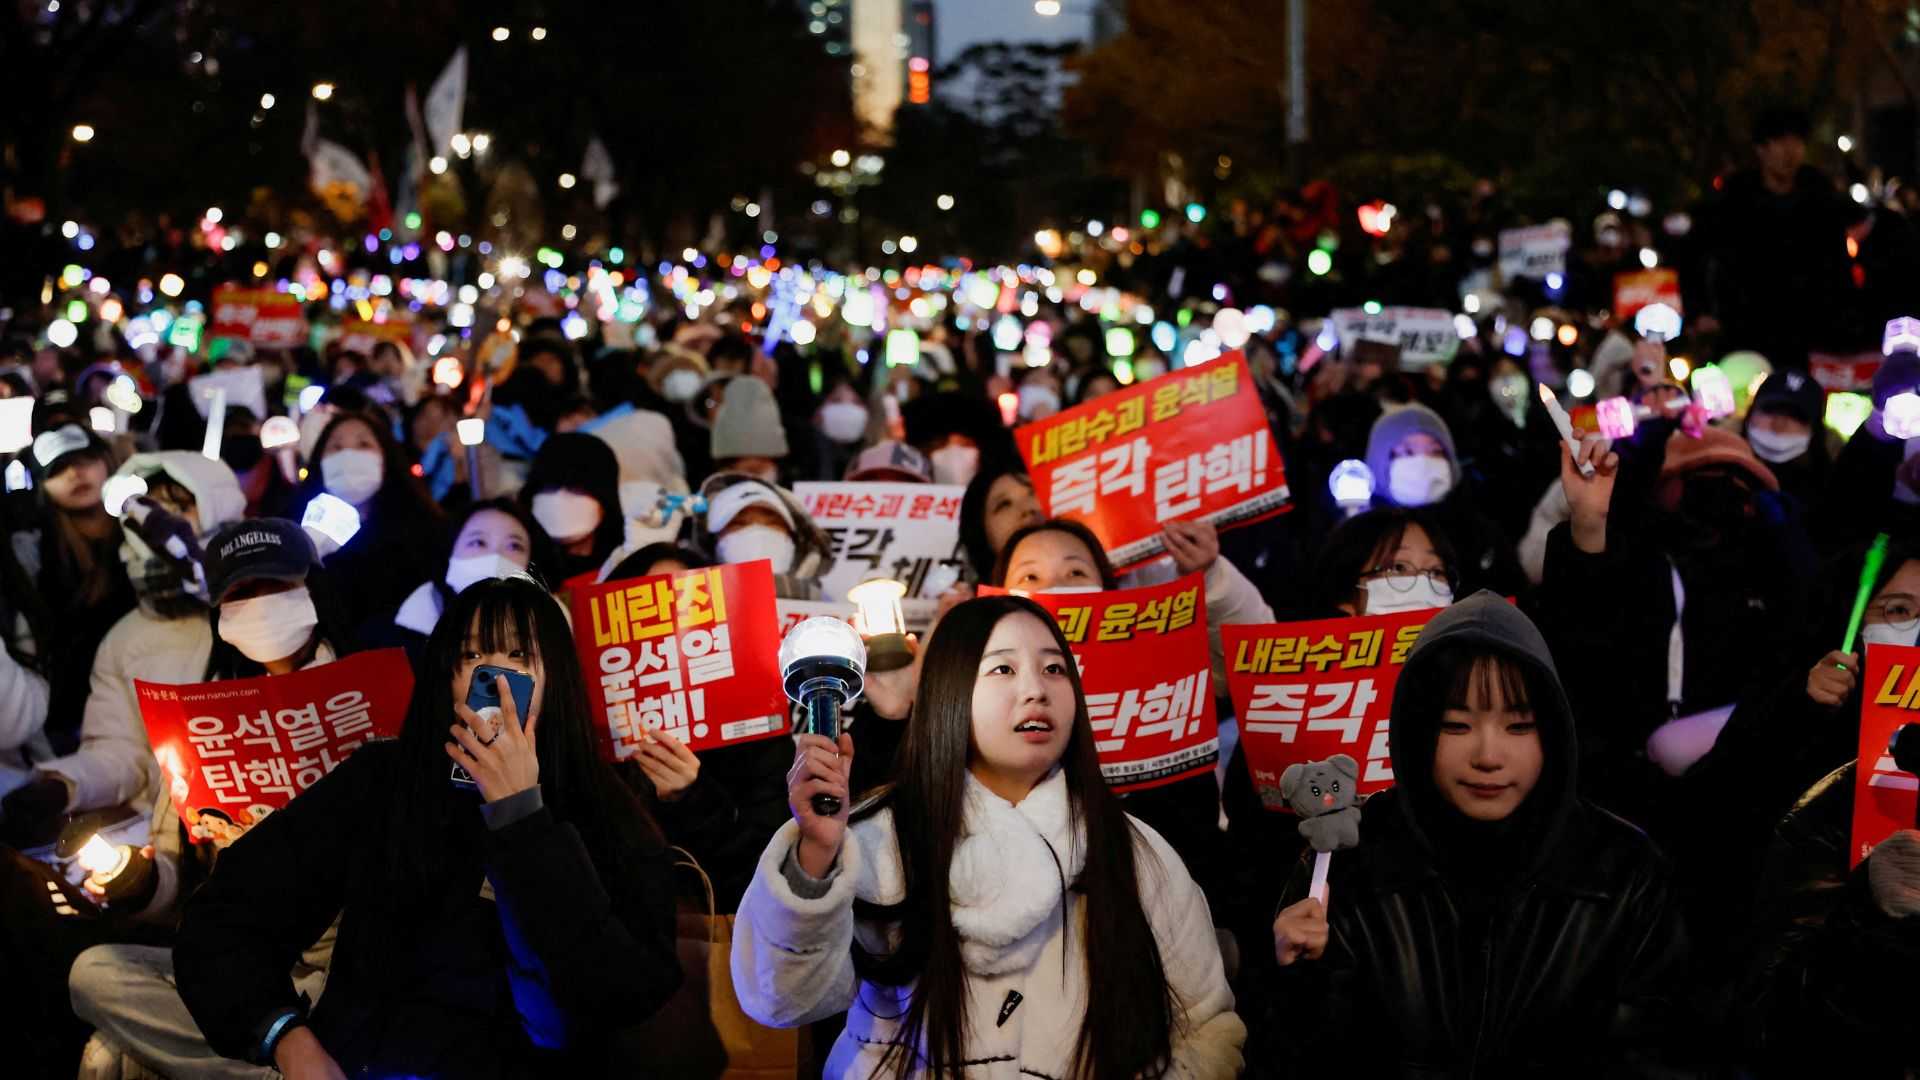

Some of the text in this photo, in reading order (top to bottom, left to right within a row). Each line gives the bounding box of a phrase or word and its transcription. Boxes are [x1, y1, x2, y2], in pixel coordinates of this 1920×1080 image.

[1032, 362, 1239, 466] 내란수괴 윤석열
[908, 494, 961, 520] 윤석
[1050, 436, 1152, 517] 즉각
[1155, 429, 1268, 522] 탄핵!
[590, 568, 727, 647] 내란죄
[1097, 586, 1198, 641] 윤석열
[599, 624, 735, 704] 윤석열
[1234, 629, 1384, 673] 내란수괴
[187, 690, 374, 759] 윤석열을
[606, 688, 709, 759] 탄핵!
[1085, 668, 1208, 752] 탄핵!
[1245, 678, 1377, 743] 즉각
[201, 738, 362, 803] 탄핵하
